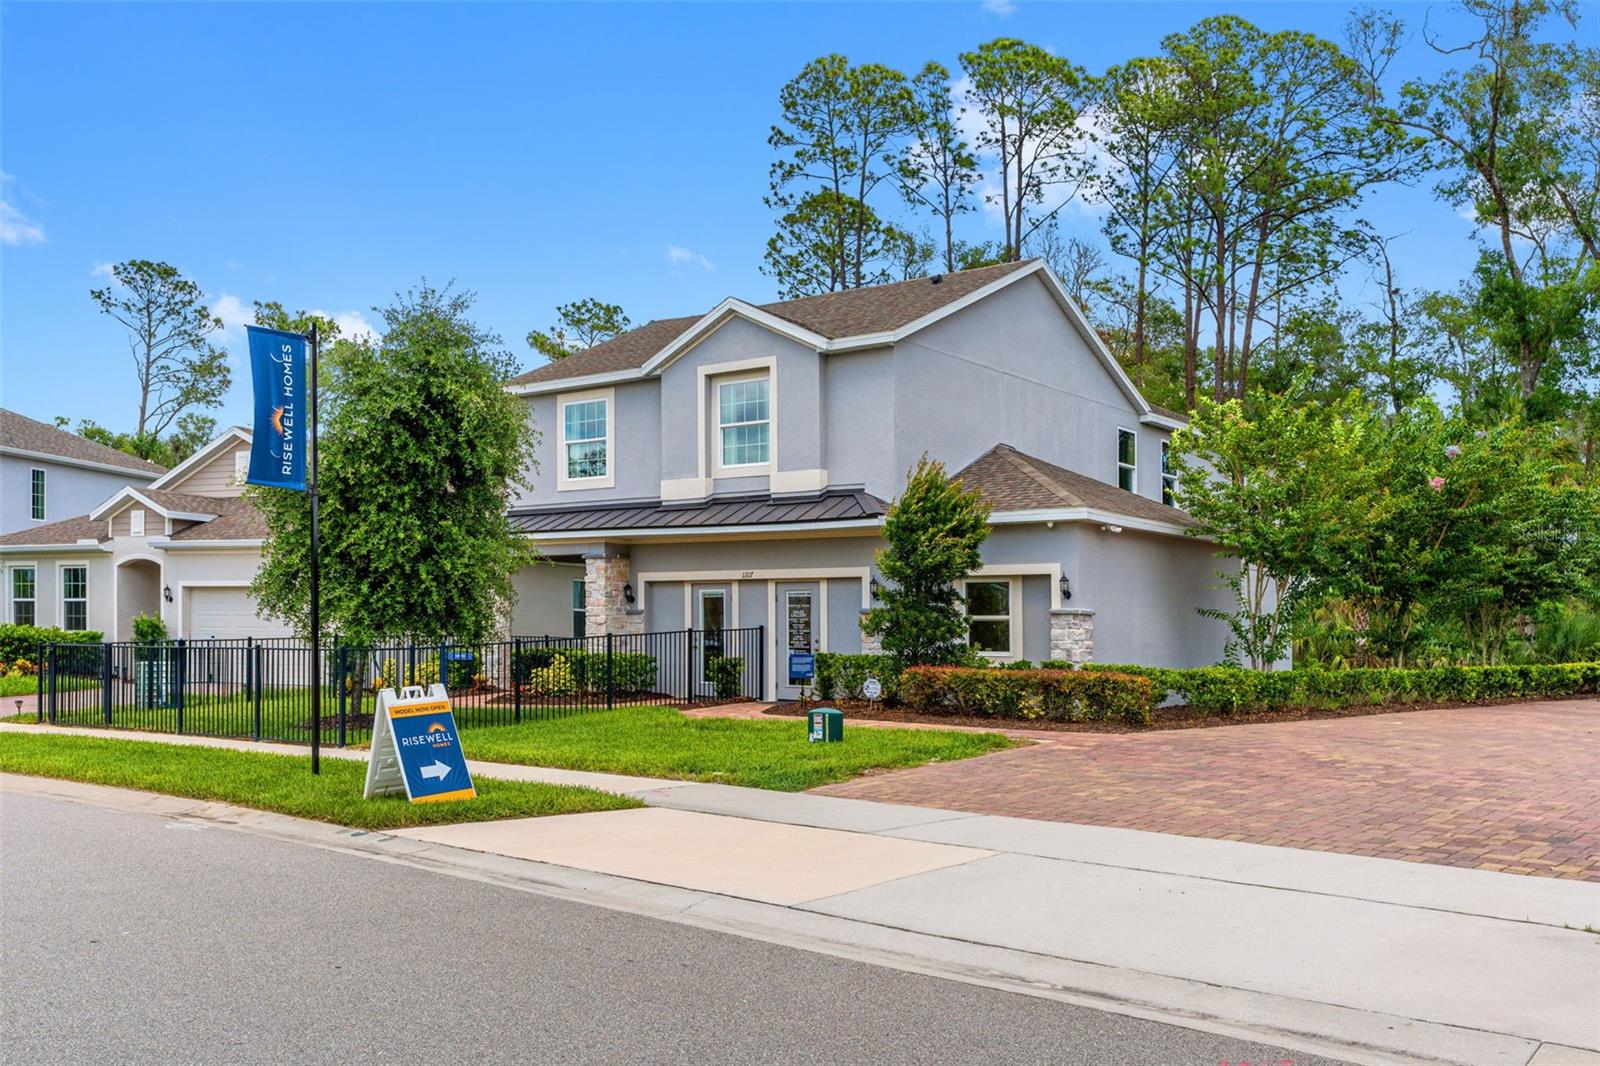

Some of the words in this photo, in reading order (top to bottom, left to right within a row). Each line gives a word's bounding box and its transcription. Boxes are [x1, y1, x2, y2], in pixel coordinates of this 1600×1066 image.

[281, 344, 293, 396] HOMES
[282, 403, 294, 475] RISEWELL
[401, 732, 454, 747] RISEWELL
